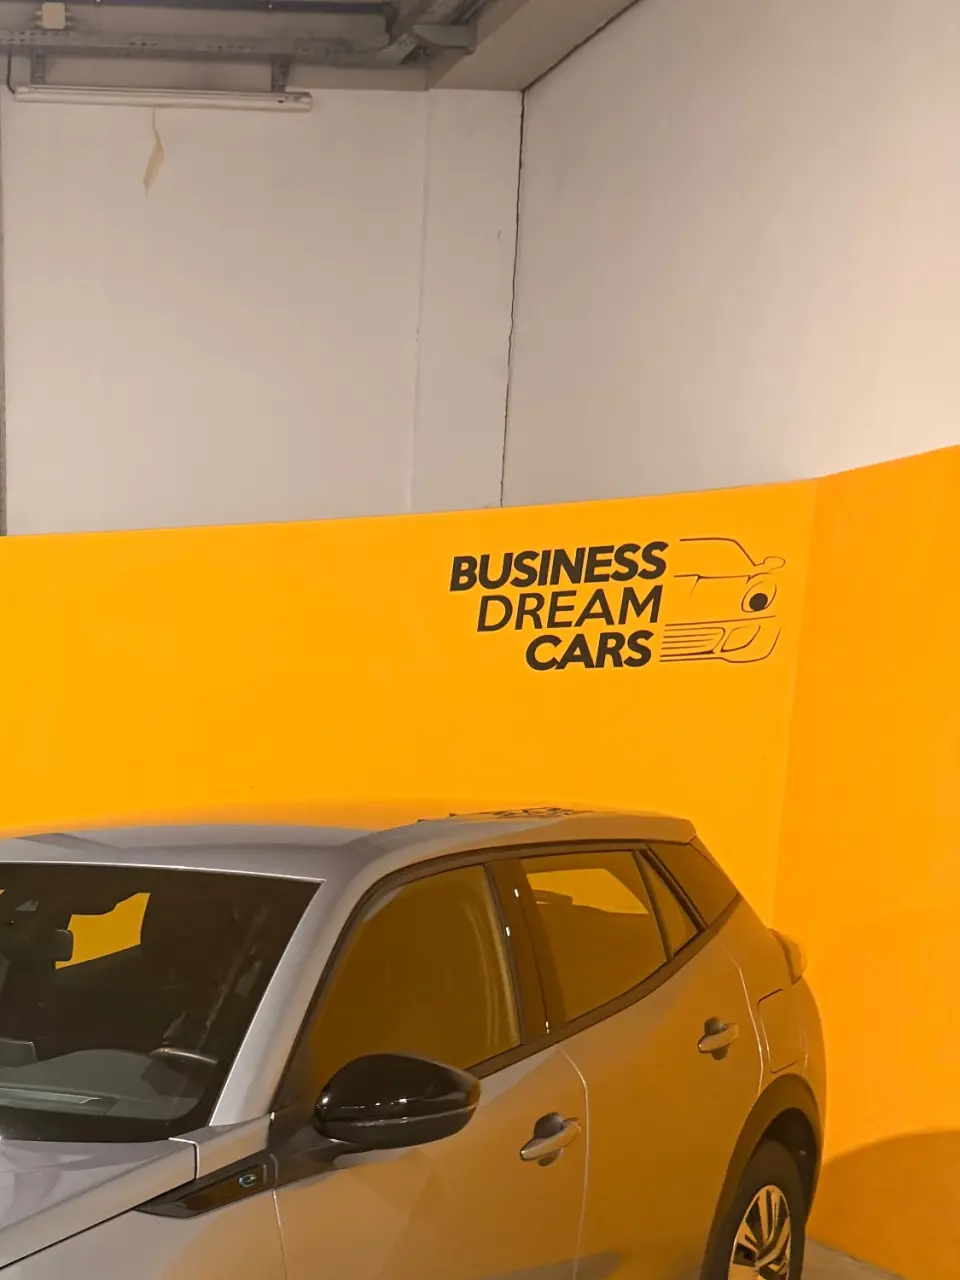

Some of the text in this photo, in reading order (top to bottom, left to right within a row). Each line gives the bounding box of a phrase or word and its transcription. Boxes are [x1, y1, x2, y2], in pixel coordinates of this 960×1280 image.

[449, 541, 669, 592] BUSINESS
[477, 585, 663, 632] DREAM
[525, 630, 654, 671] CARS
